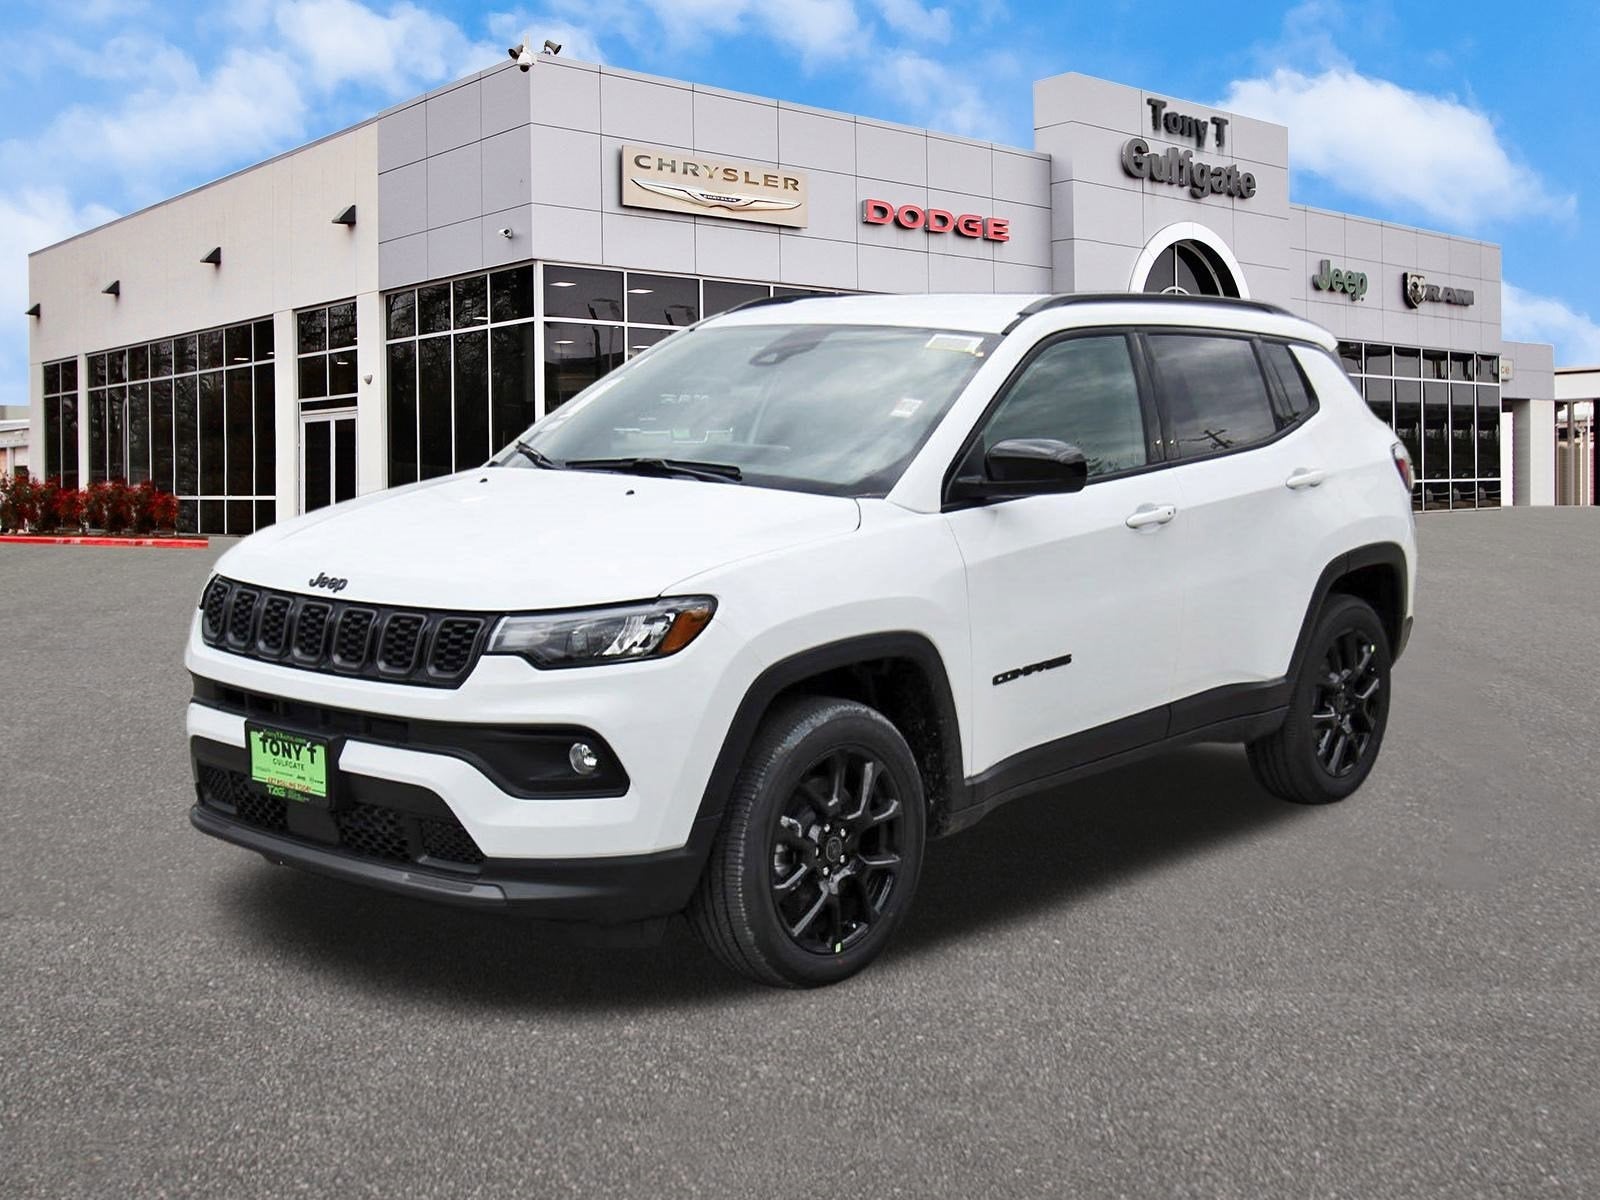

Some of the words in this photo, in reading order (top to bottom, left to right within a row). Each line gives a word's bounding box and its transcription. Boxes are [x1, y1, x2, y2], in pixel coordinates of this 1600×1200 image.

[1147, 98, 1208, 147] Tony
[1210, 117, 1229, 147] T
[633, 153, 801, 192] CHRYSLER
[1121, 138, 1257, 199] Gulfgate
[862, 199, 1010, 242] DODGE
[1312, 259, 1368, 302] Jeep
[1425, 284, 1475, 306] RAM
[309, 572, 348, 593] Jeep
[259, 736, 303, 761] TONY
[306, 746, 317, 765] T
